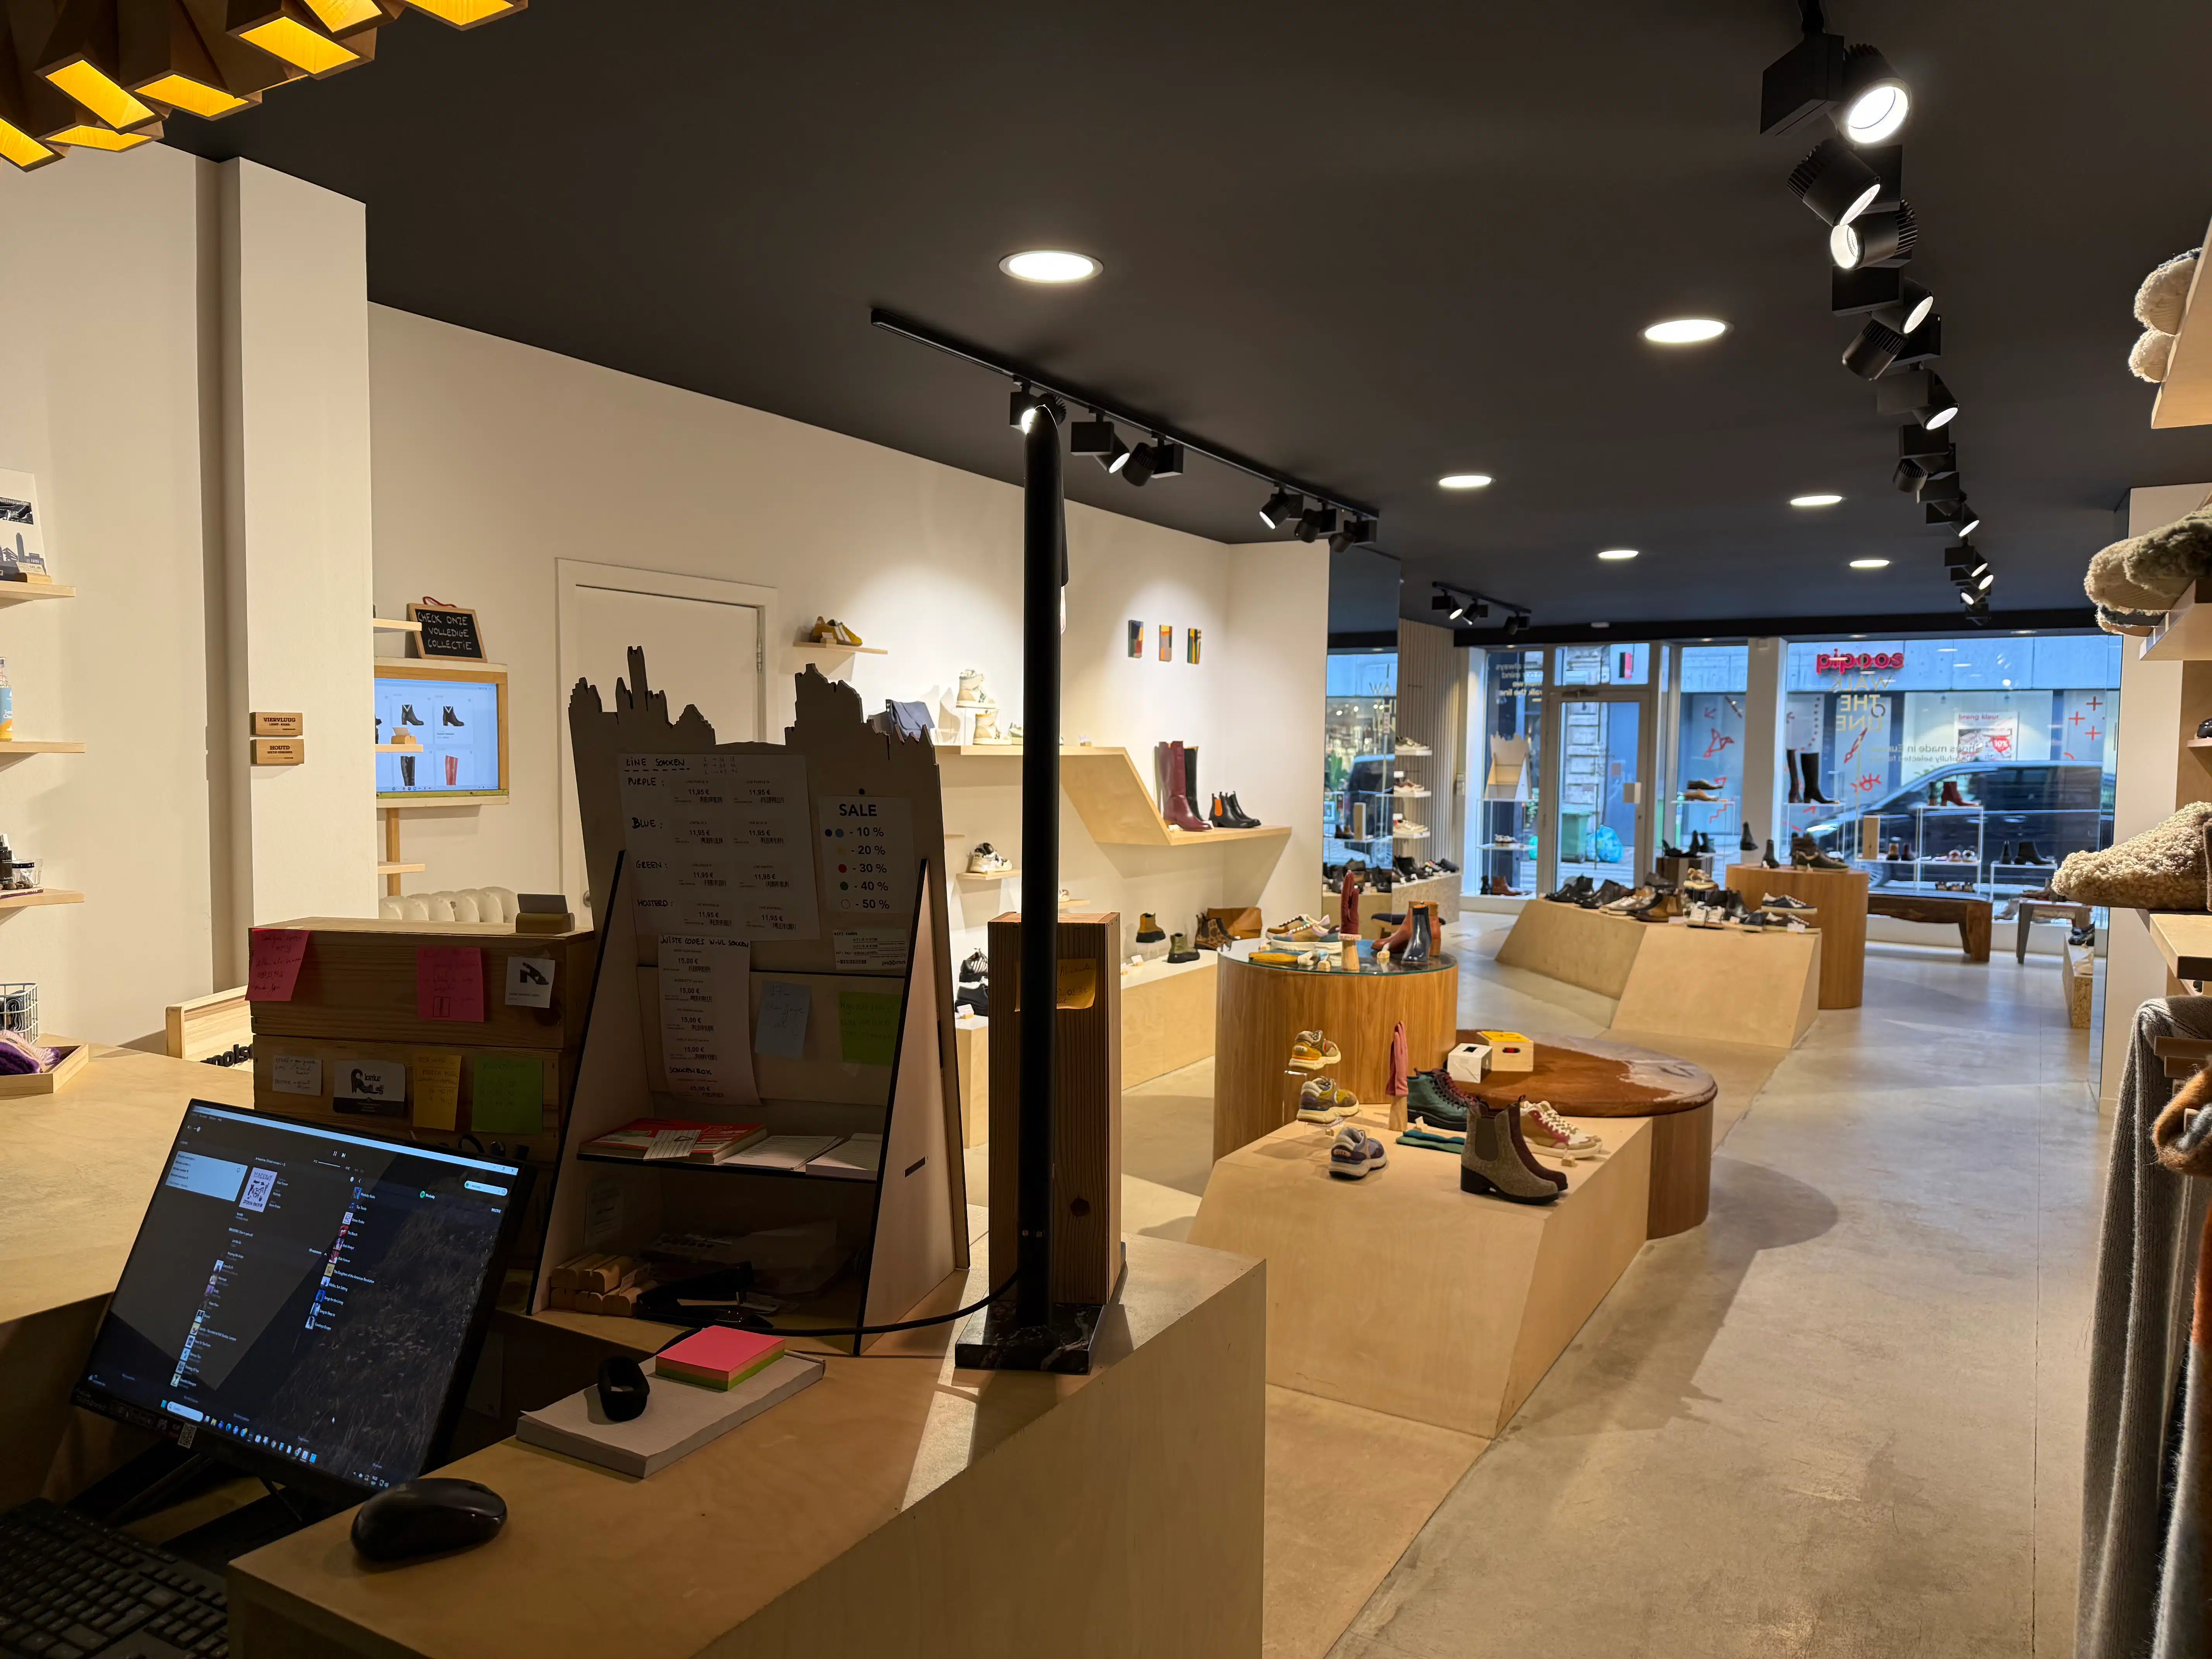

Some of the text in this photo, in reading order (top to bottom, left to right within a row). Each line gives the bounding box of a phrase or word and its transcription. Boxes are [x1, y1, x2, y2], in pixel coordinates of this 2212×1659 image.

[418, 612, 468, 625] CHECK ONZE
[1816, 648, 1905, 675] pipoos
[655, 758, 685, 766] SOKKEN
[628, 777, 656, 786] PURPLE
[839, 804, 877, 817] SALE
[632, 817, 656, 829] BLUE
[857, 827, 870, 836] 10
[873, 827, 884, 837] %
[858, 845, 871, 855] 20
[874, 846, 885, 855] %
[635, 860, 662, 869] GREEN
[859, 863, 873, 872] 30
[876, 863, 887, 873] %
[861, 881, 874, 891] 40
[877, 881, 888, 891] %
[862, 899, 876, 908] 50
[879, 900, 890, 909] %
